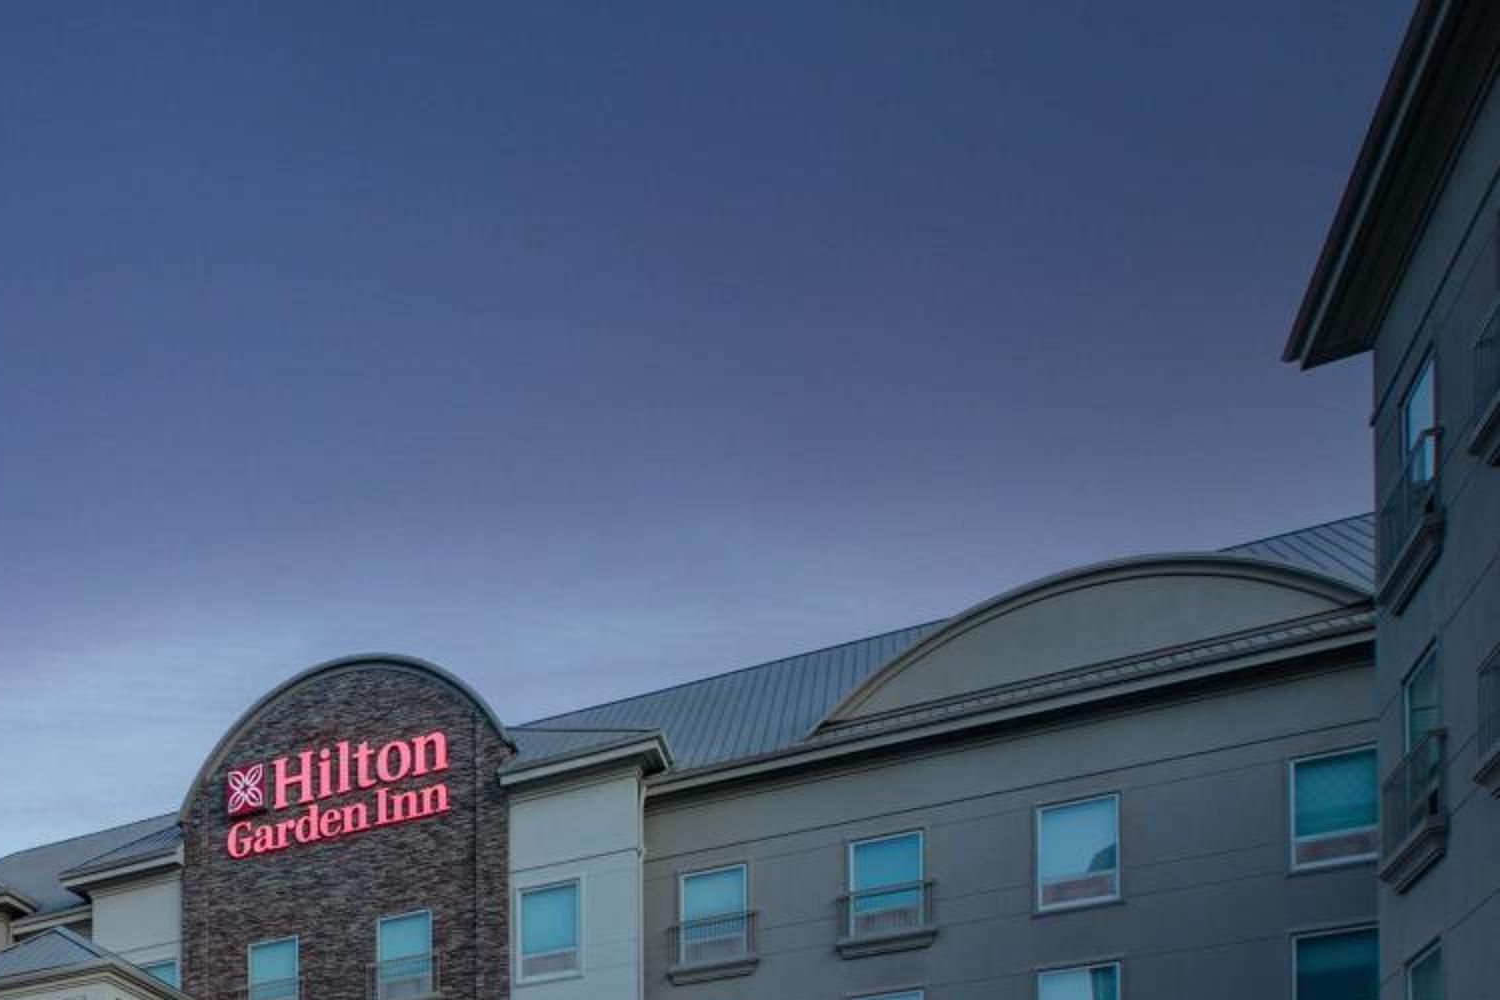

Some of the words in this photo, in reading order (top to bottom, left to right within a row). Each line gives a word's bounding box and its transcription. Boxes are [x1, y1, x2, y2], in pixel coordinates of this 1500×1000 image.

[272, 730, 449, 809] Hilton
[227, 800, 371, 859] Garden
[373, 781, 451, 827] Inn
